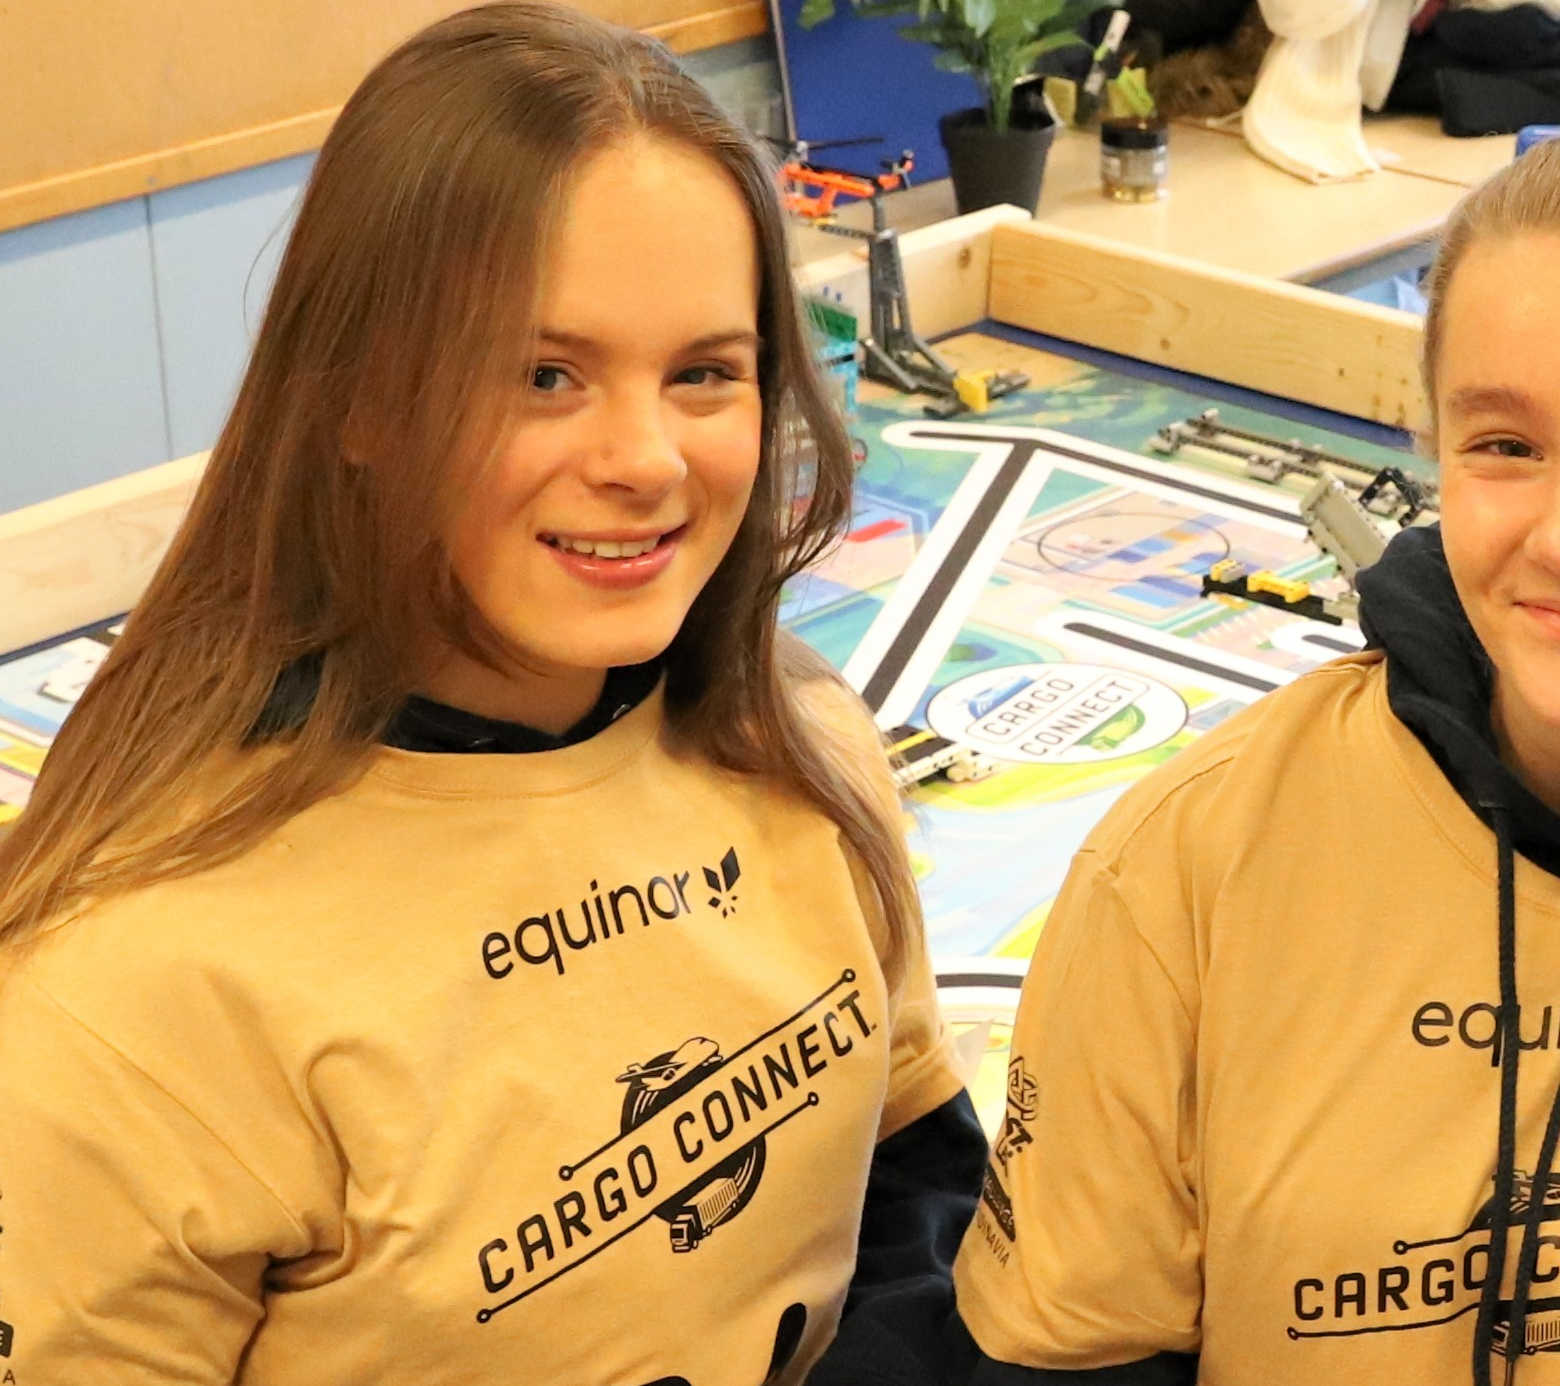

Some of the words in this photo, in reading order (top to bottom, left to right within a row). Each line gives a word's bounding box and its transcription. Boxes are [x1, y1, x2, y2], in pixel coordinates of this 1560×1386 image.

[982, 678, 1076, 737] CARGO
[1019, 680, 1136, 757] CONNECT
[481, 869, 692, 980] equinor
[477, 1144, 659, 1295] CARGO
[673, 989, 873, 1163] CONNECT
[1293, 1244, 1491, 1321] CARGO
